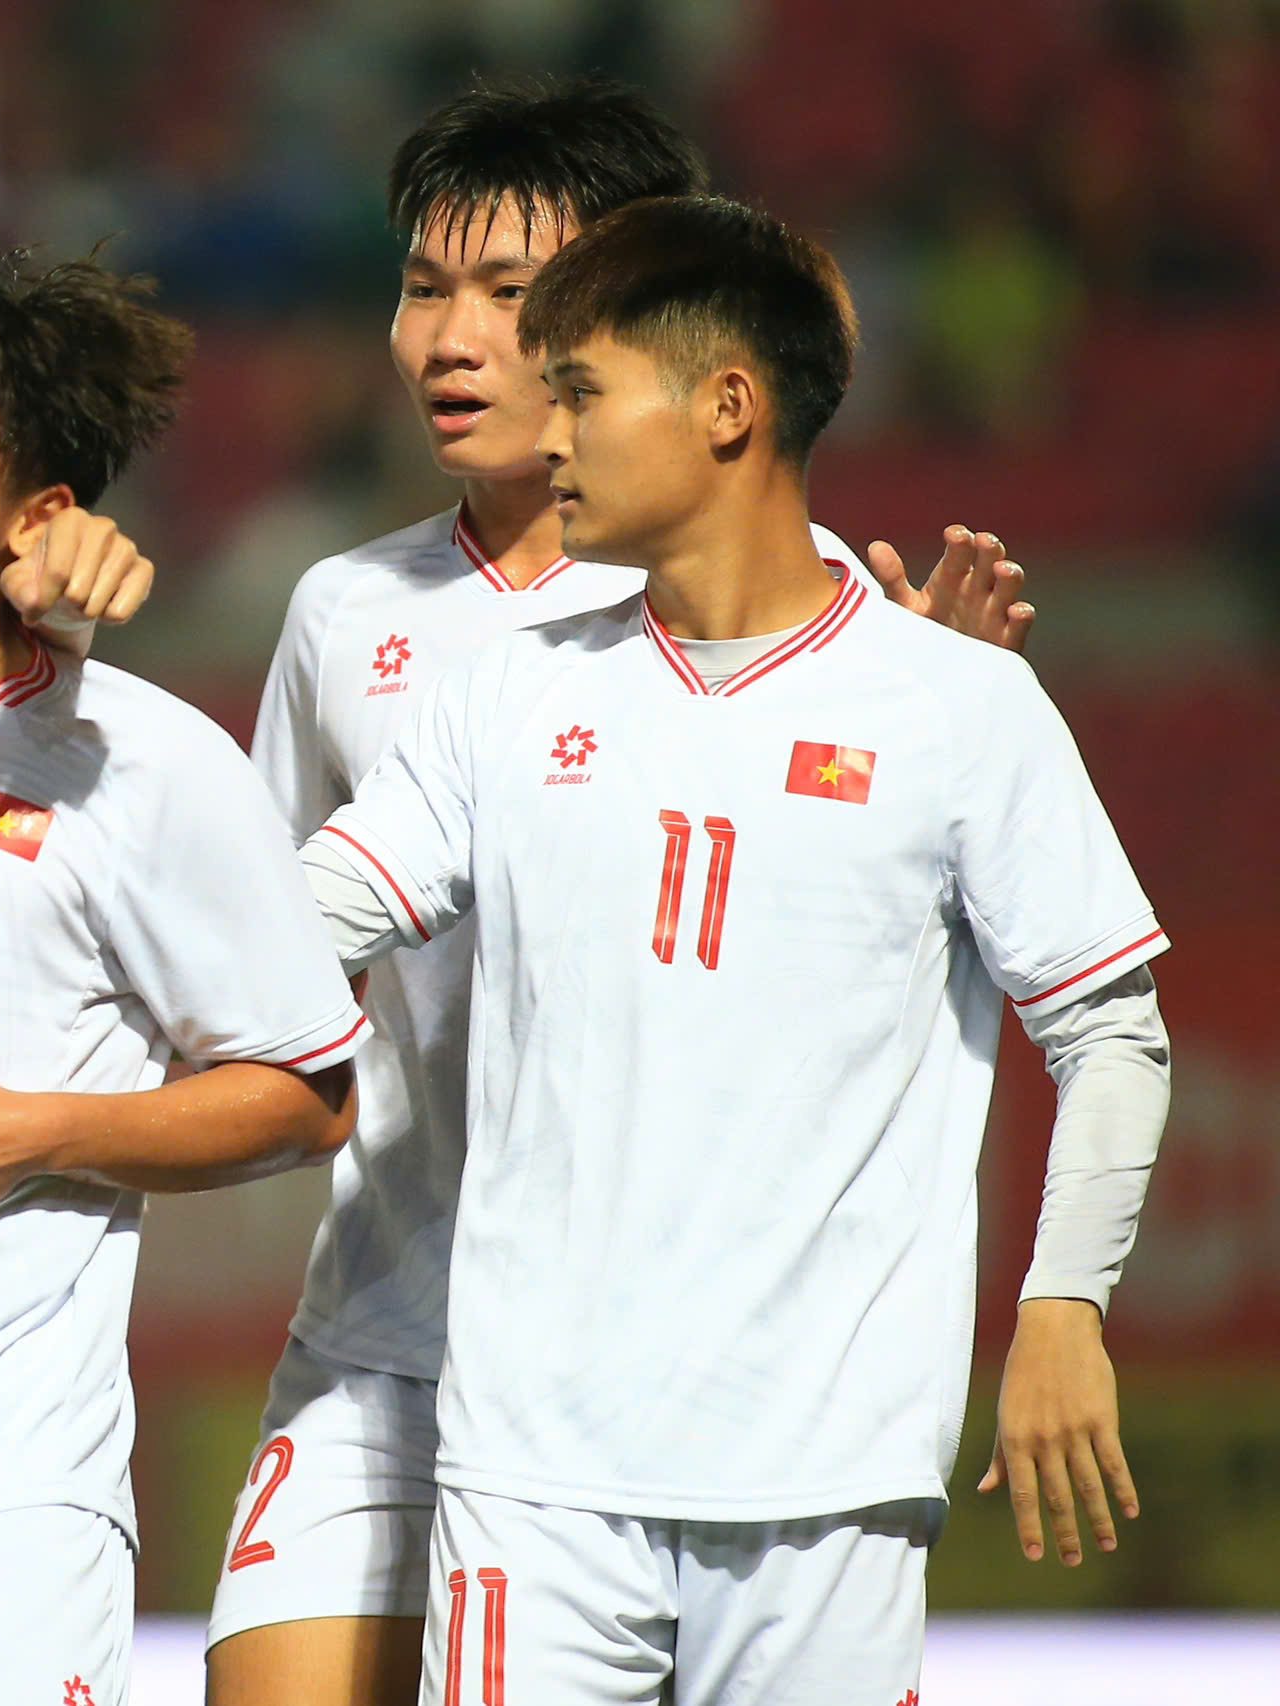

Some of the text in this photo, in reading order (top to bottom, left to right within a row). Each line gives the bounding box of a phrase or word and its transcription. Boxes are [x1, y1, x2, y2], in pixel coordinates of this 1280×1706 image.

[543, 773, 593, 786] JOGARBOLA
[651, 809, 736, 971] 11
[217, 1436, 294, 1584] 2
[443, 1567, 508, 1706] 11
